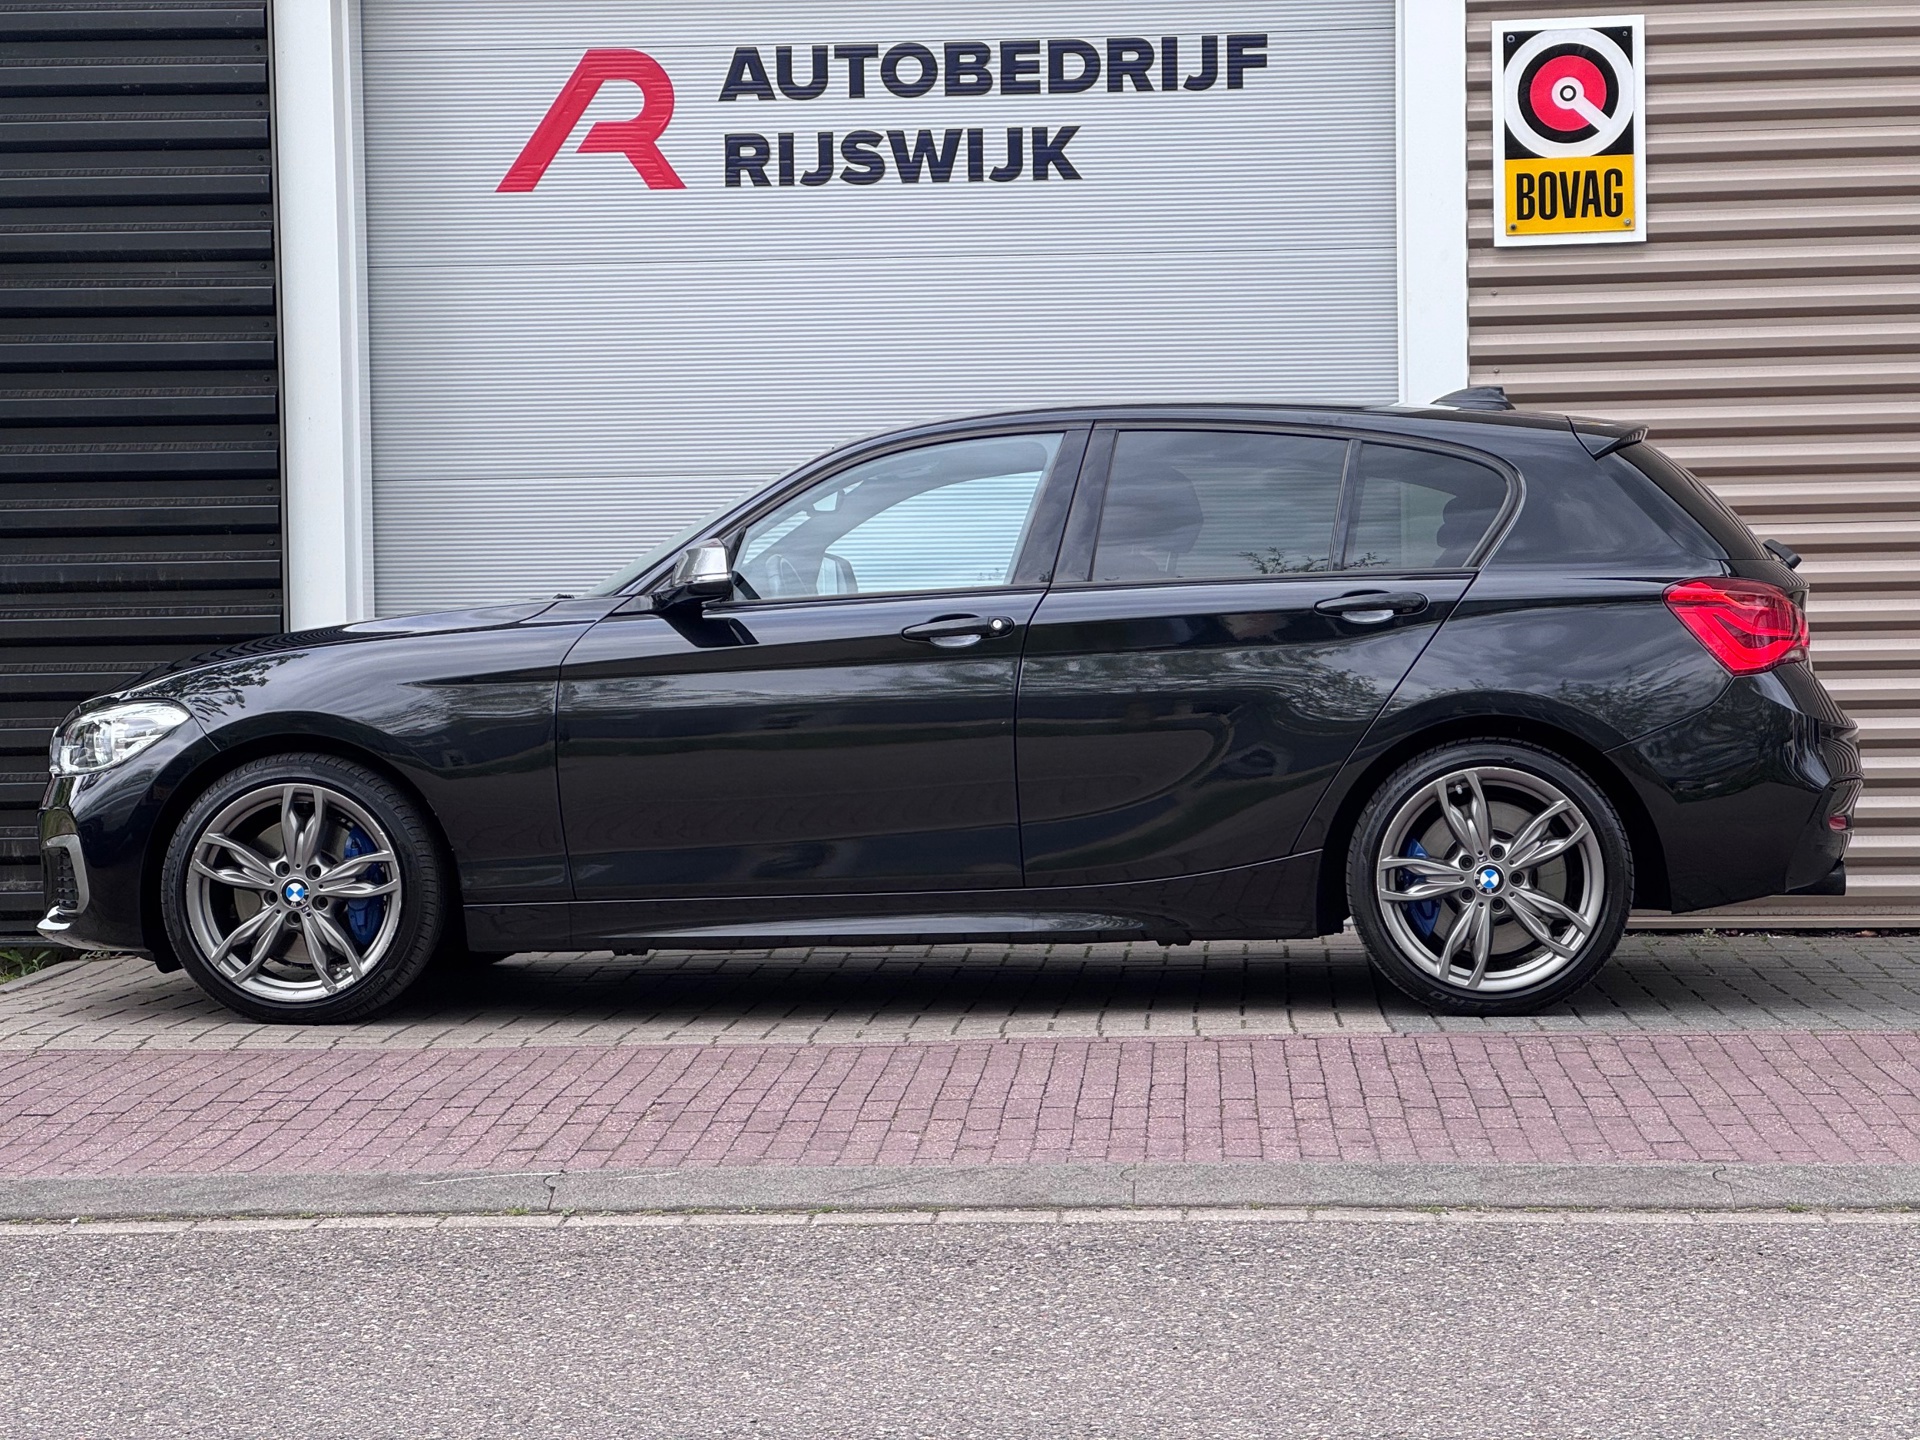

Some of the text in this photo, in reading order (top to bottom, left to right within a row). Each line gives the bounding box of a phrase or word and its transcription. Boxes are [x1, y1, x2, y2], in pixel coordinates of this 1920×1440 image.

[718, 33, 1269, 102] AUTOBEDRIJF
[724, 125, 1082, 188] RIJSWIJK
[1516, 168, 1624, 221] BOVAG
